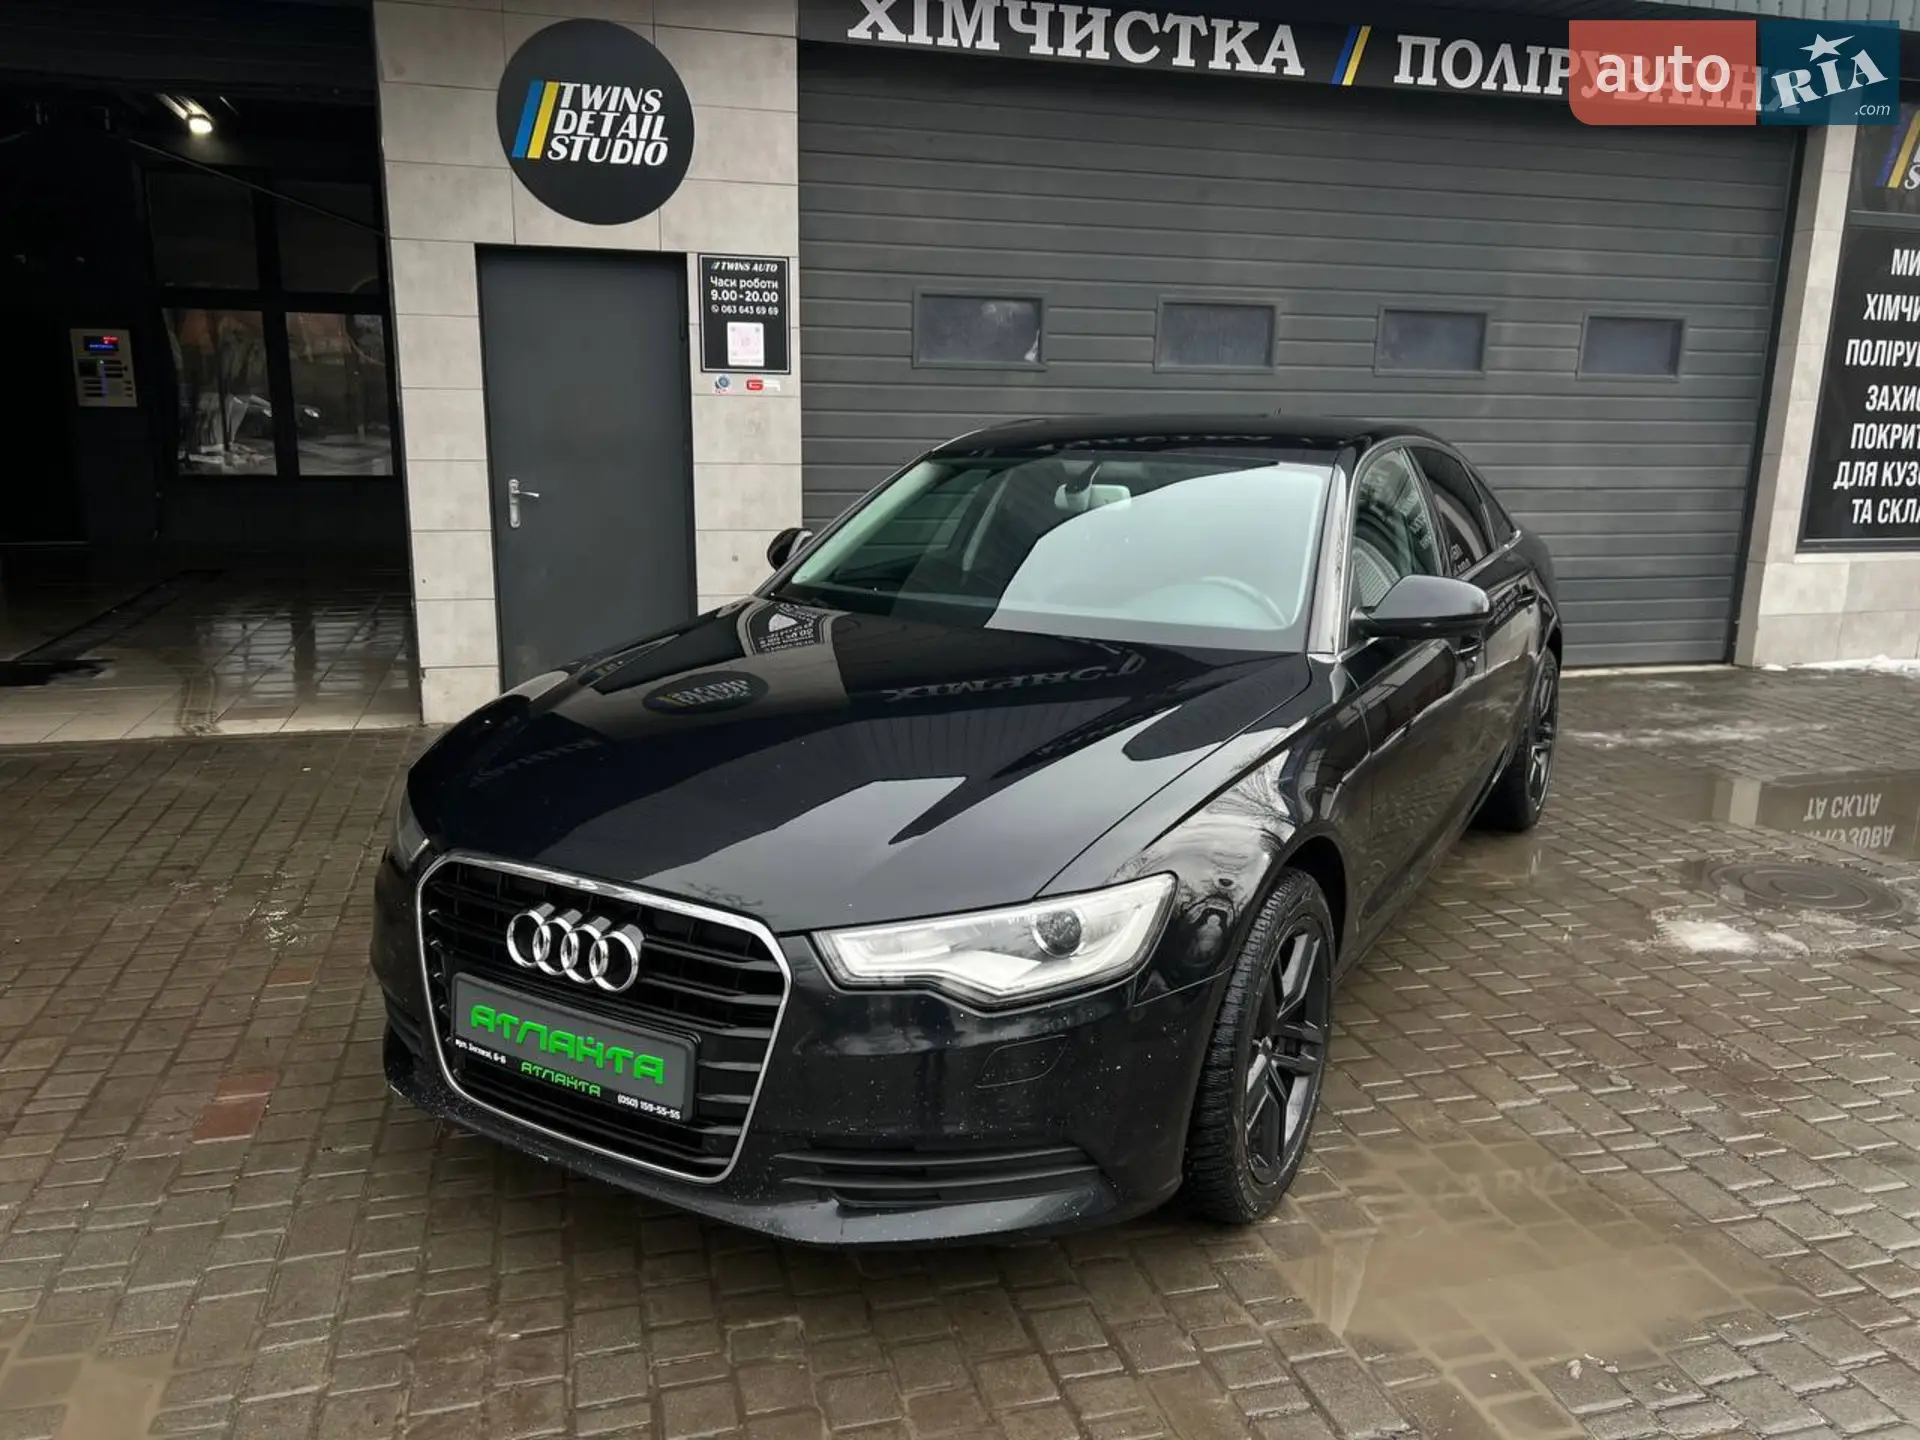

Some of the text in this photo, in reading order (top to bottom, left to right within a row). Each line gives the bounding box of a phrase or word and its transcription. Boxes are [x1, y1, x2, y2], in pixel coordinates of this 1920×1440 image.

[847, 0, 1305, 76] ХІМЧИСТКА
[558, 82, 663, 114] TWINS
[553, 110, 669, 142] DETAIL
[547, 135, 669, 166] STUDIO
[720, 262, 778, 272] TWINS AUTO
[710, 276, 778, 290] Часи роботи
[1833, 460, 1920, 490] ДЛЯ КУЗ
[1852, 498, 1872, 524] ТА
